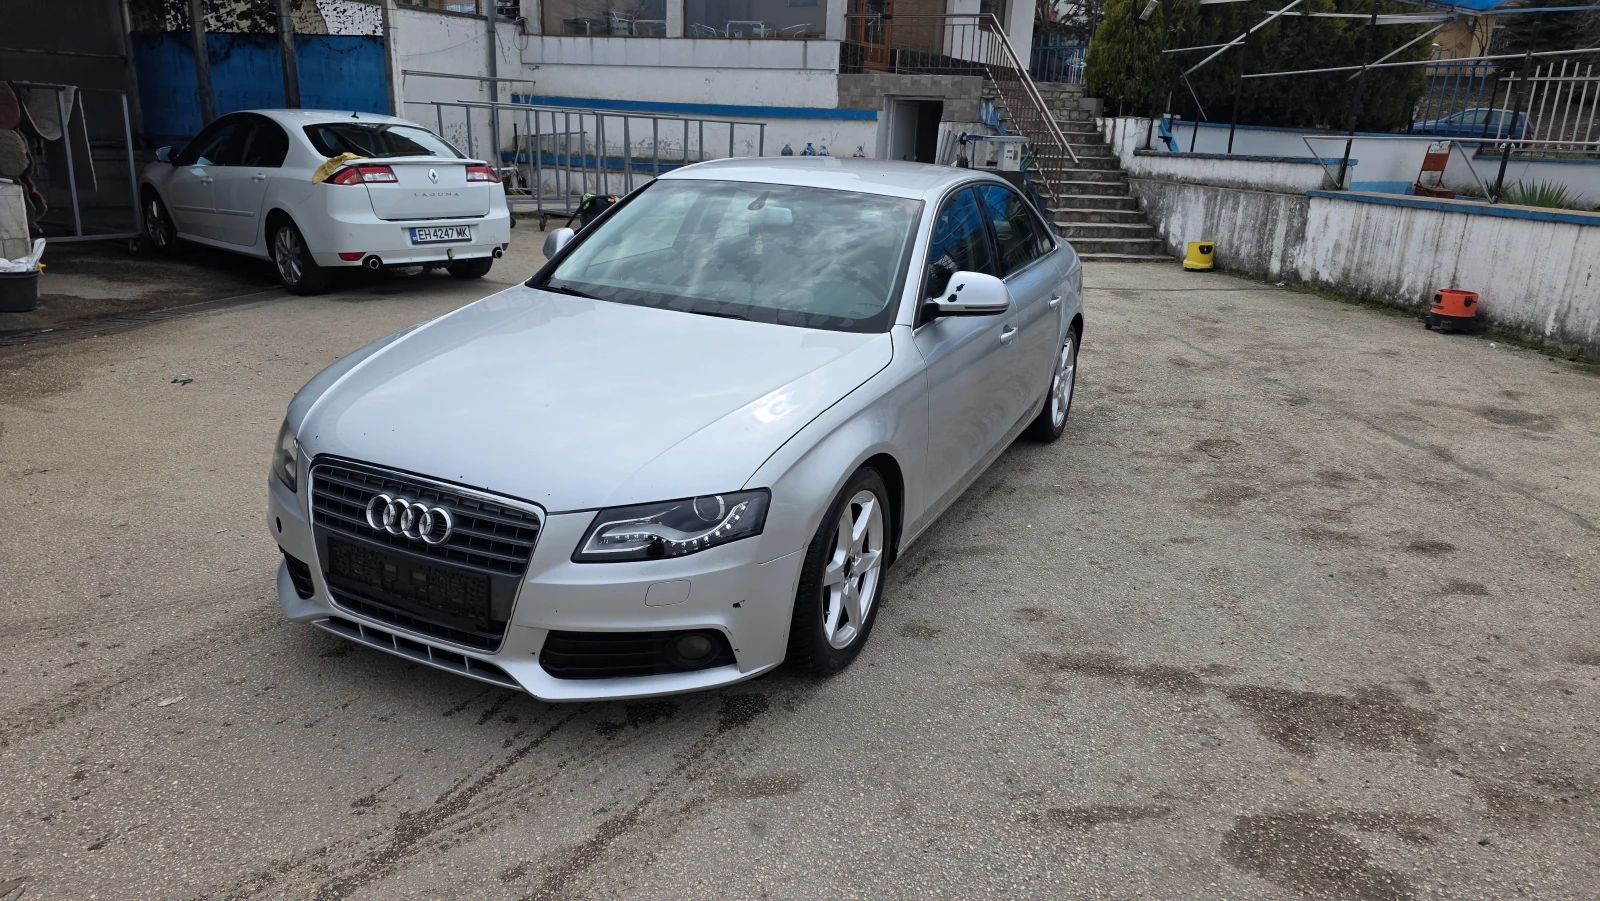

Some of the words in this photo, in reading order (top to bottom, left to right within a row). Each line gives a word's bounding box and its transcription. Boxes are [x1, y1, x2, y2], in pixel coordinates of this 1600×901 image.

[417, 229, 432, 240] EH
[433, 228, 454, 239] 4247
[455, 227, 469, 238] MK
